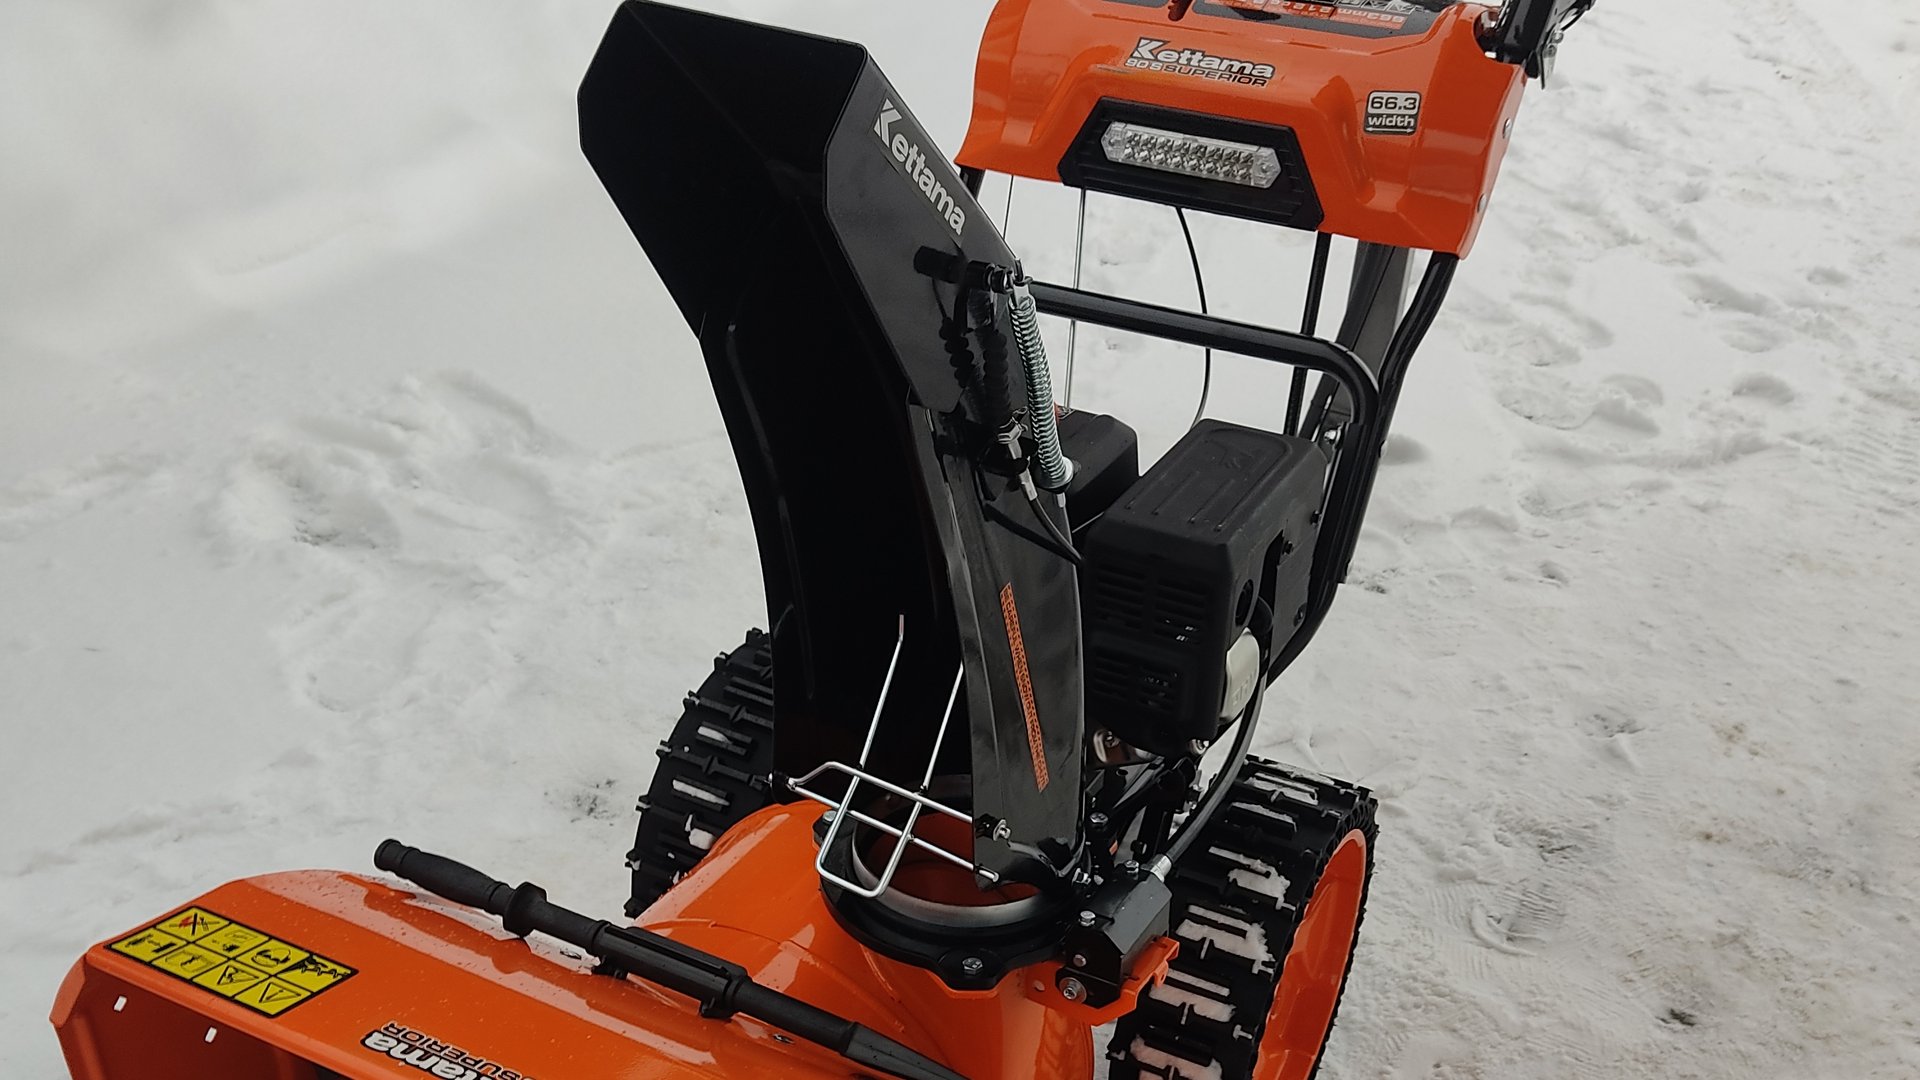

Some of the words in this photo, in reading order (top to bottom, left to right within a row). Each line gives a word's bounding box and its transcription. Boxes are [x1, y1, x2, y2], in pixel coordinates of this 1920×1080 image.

[1132, 38, 1273, 78] Kettama
[1163, 64, 1268, 87] SUPERIOR
[1371, 96, 1417, 110] 66.3
[1367, 114, 1415, 127] width
[873, 98, 966, 236] Kettama
